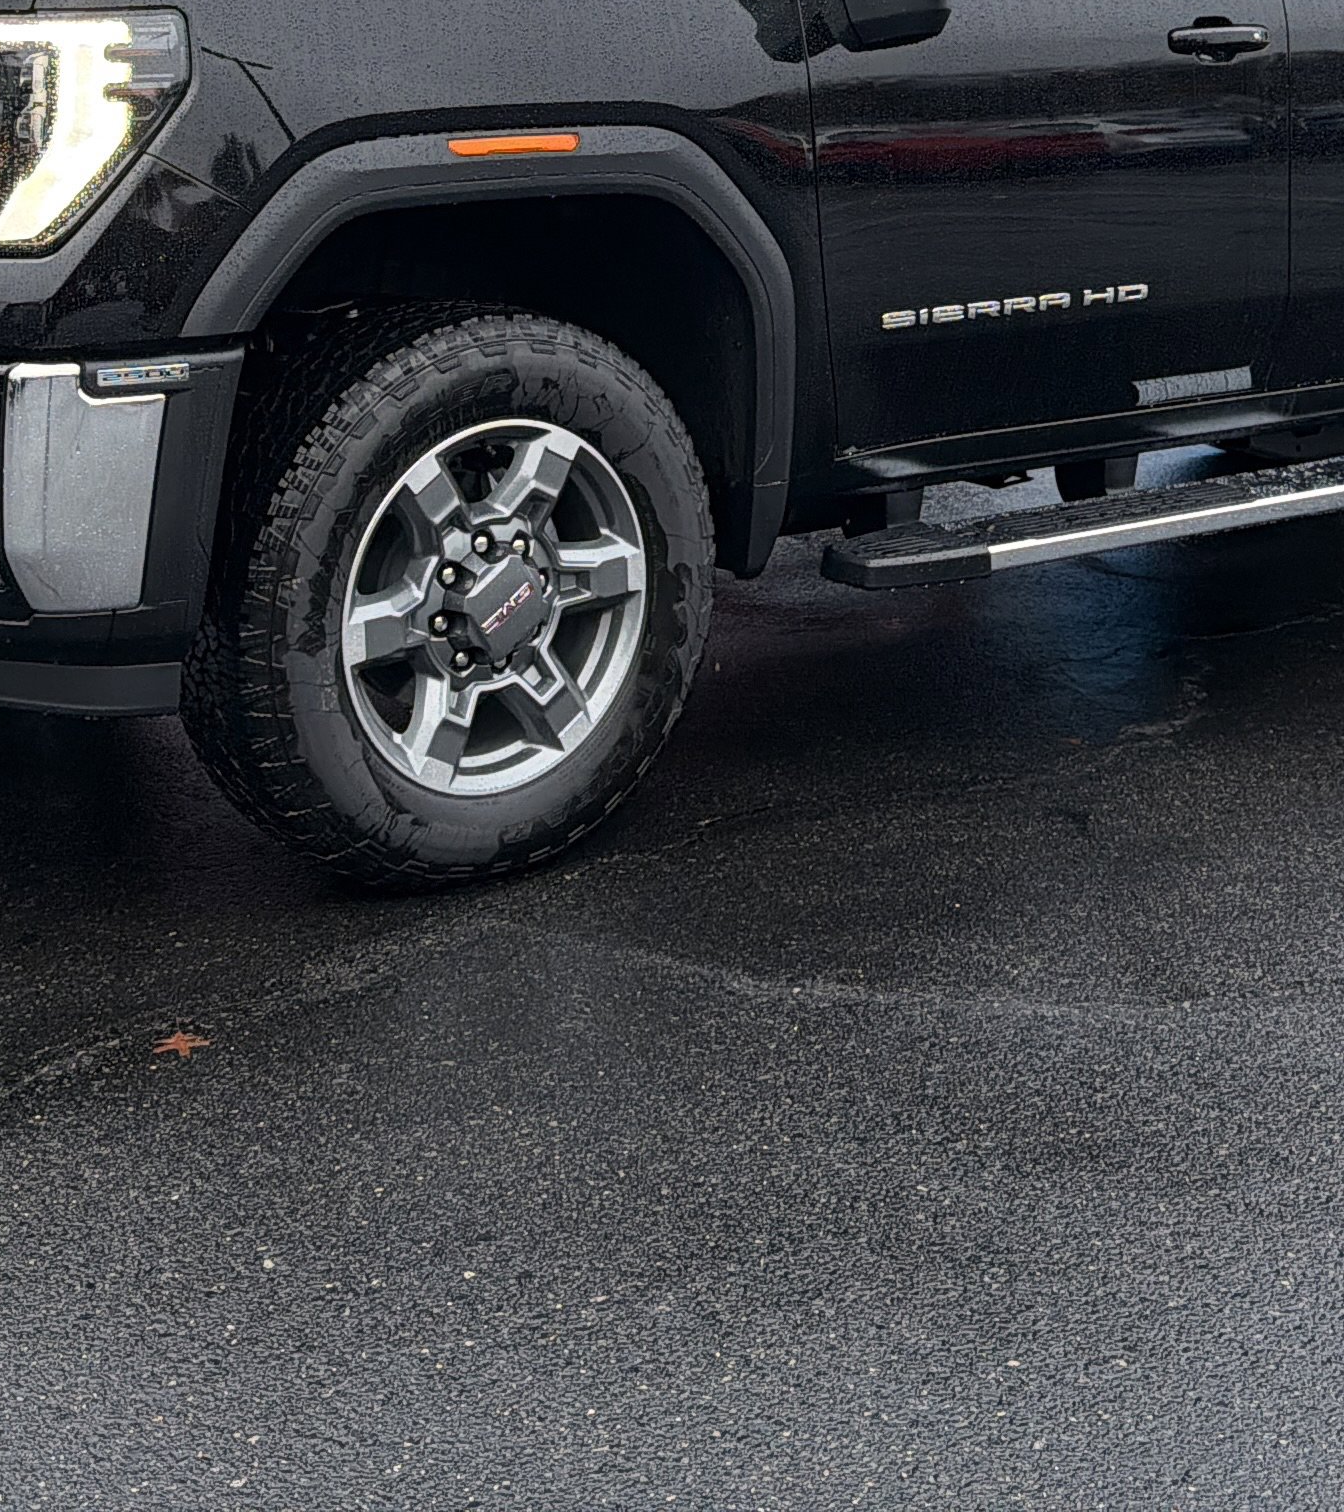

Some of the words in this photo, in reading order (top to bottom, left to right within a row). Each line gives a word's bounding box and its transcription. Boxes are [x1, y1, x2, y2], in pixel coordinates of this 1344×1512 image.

[882, 292, 1071, 330] SIERRA
[1083, 283, 1149, 307] HD
[480, 581, 535, 635] GMC
